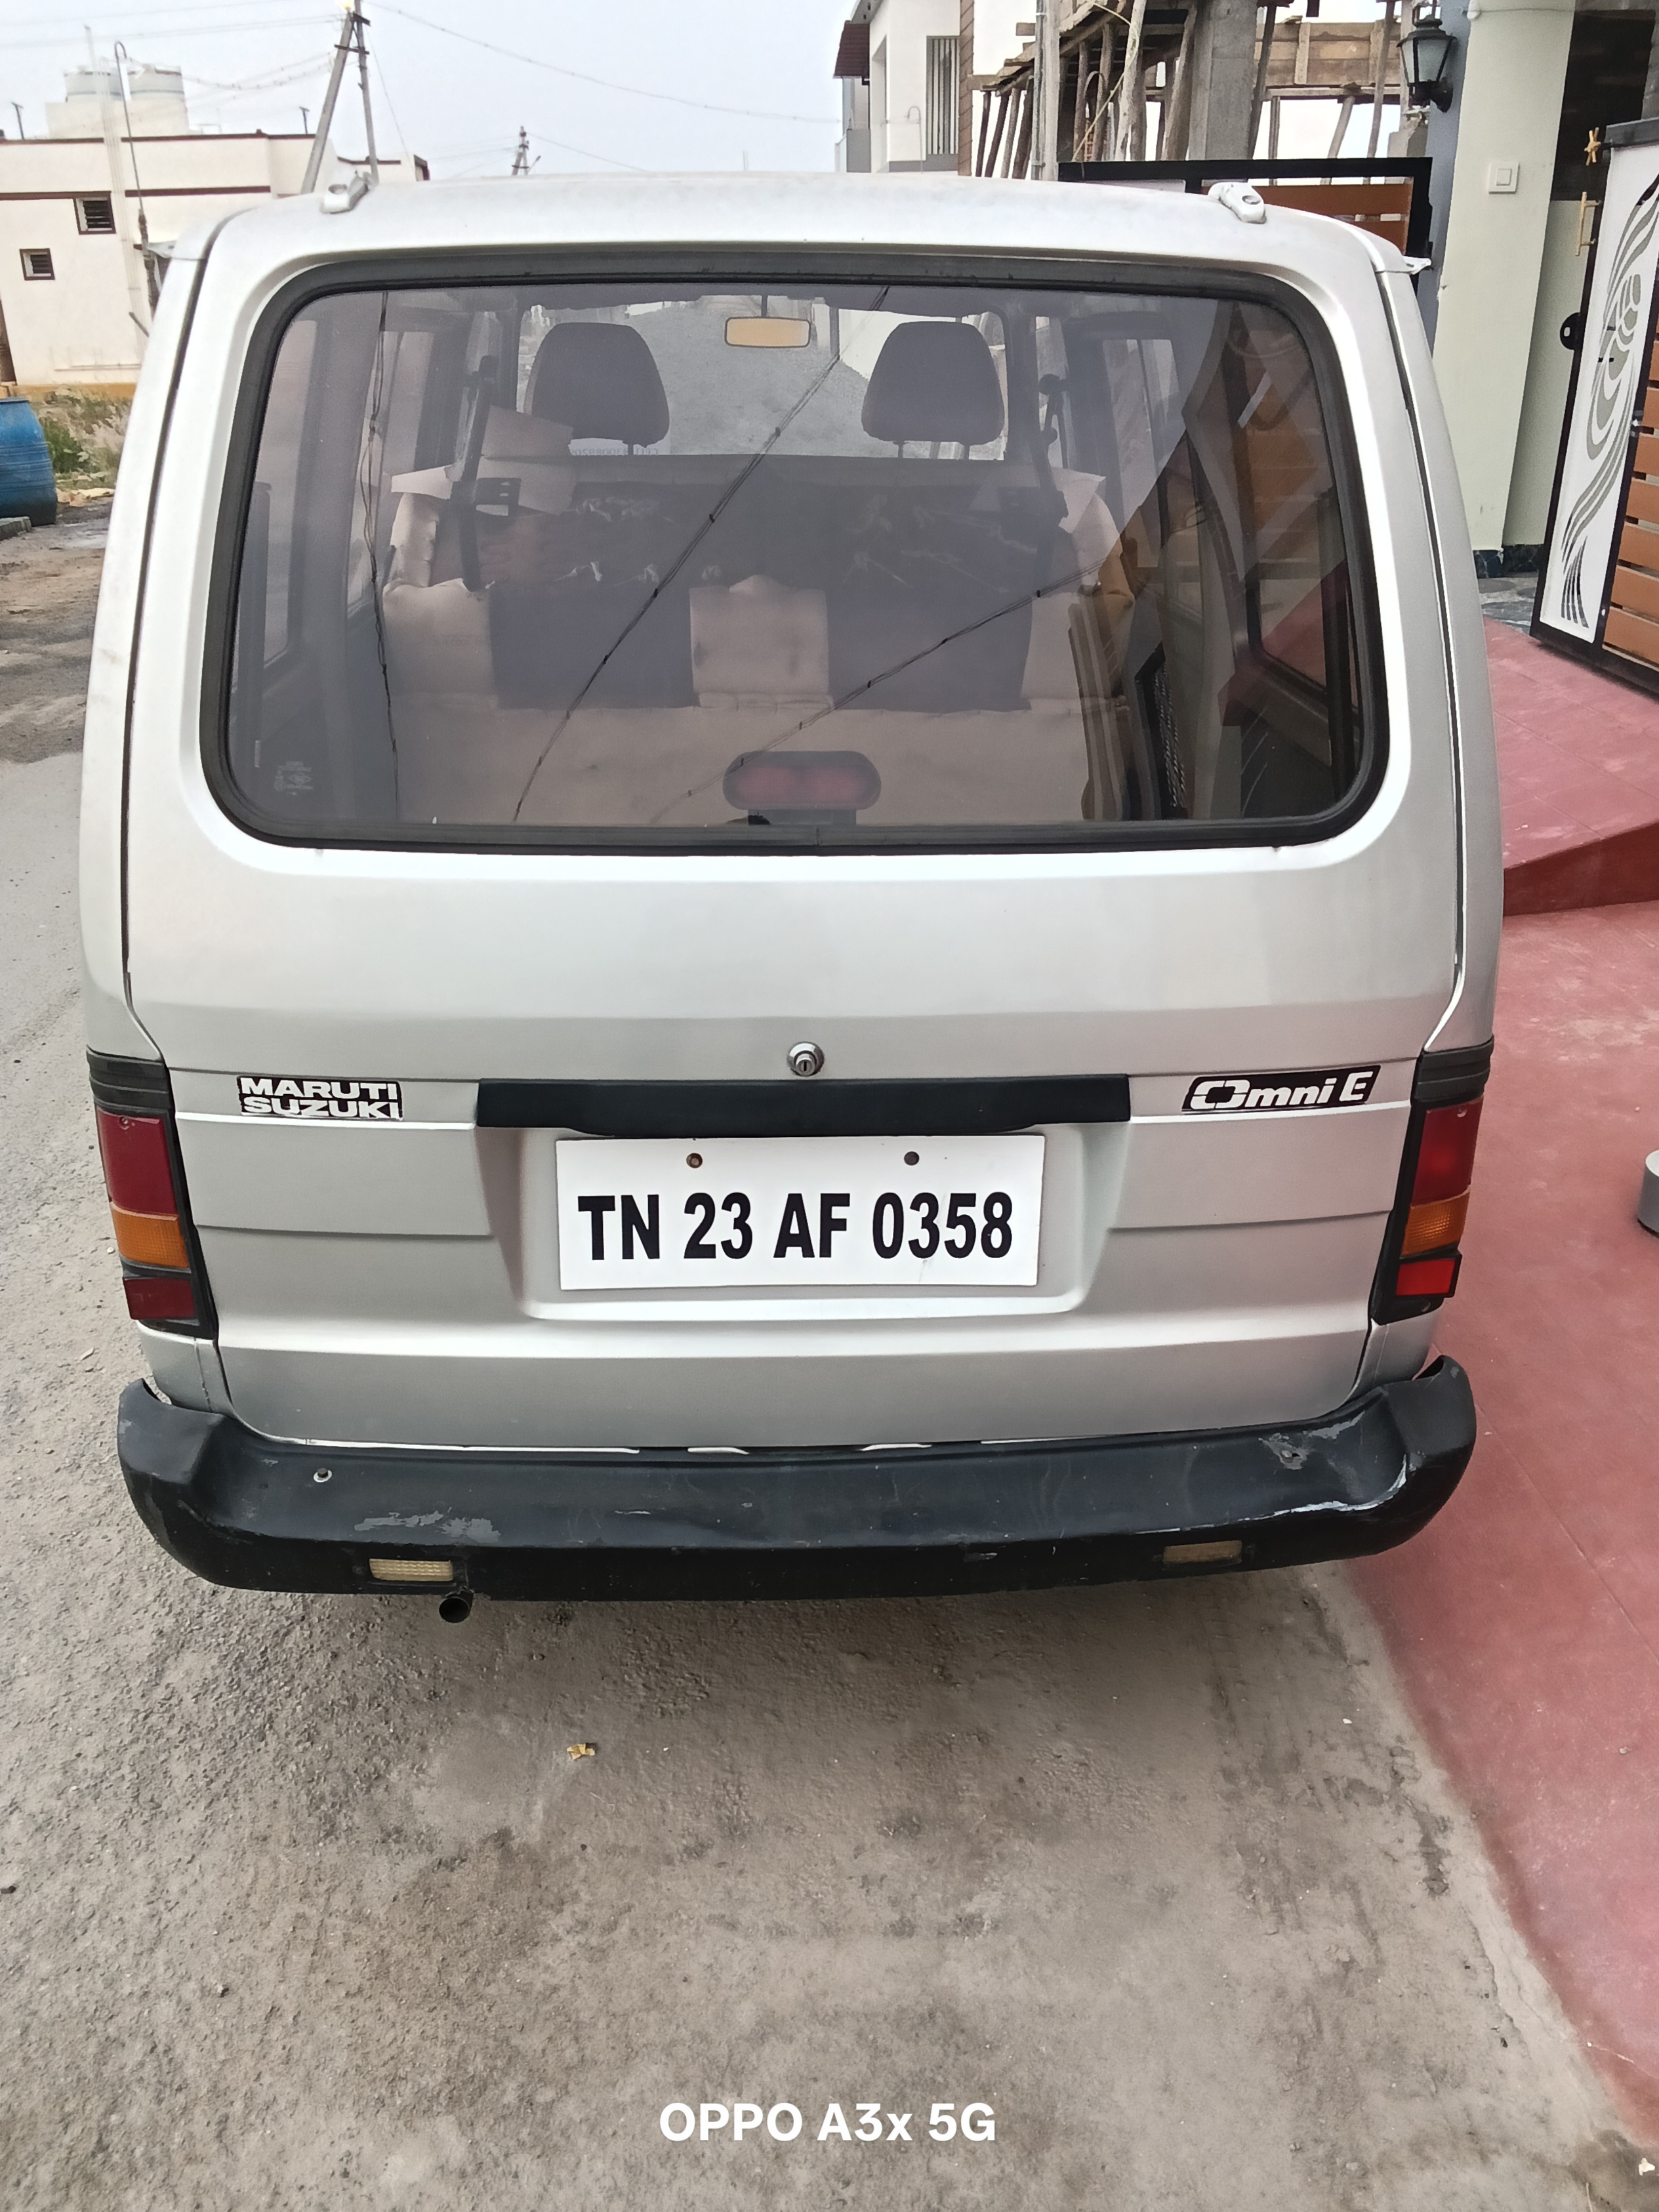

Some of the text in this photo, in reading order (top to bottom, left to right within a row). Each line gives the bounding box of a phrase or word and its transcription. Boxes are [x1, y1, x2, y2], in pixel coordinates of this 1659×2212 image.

[240, 1078, 398, 1099] MARUTI
[1190, 1071, 1374, 1109] Omni E
[243, 1097, 401, 1119] SUZUKI
[577, 1191, 1012, 1261] TN 23 AF 0358
